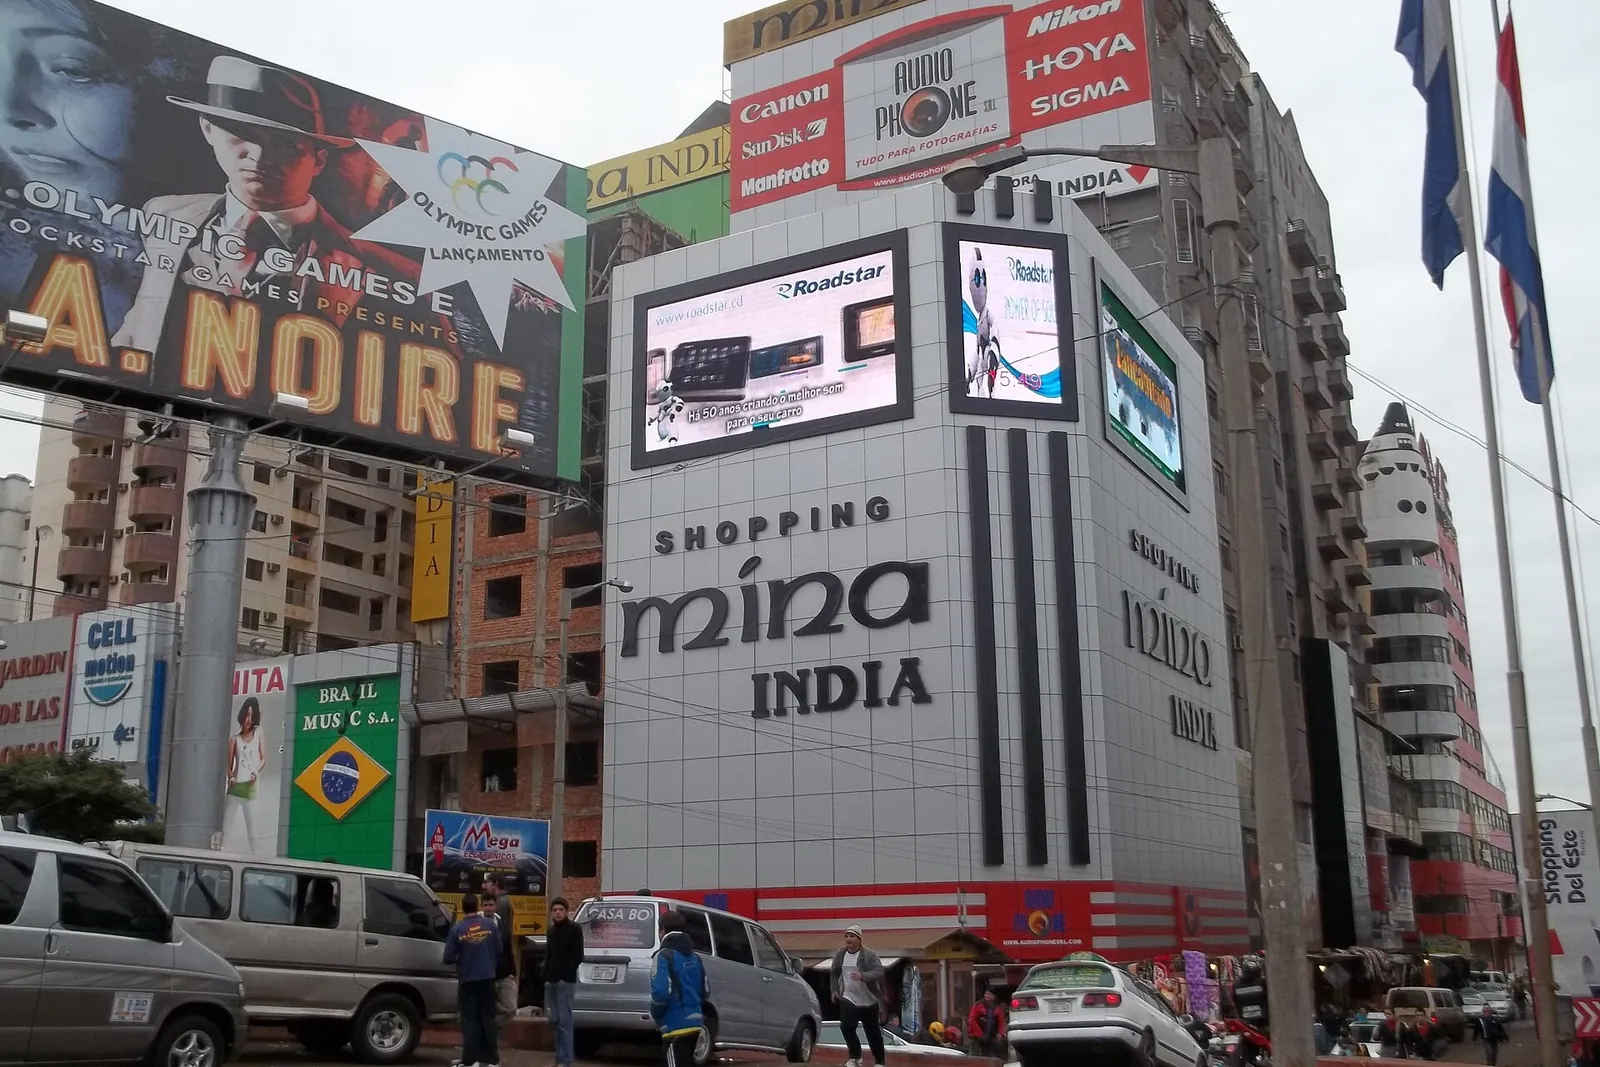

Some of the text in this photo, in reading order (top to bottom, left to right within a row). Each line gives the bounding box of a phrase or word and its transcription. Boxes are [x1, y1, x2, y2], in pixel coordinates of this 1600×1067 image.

[1026, 0, 1121, 38] Nikon
[895, 48, 953, 96] AUDIO
[1022, 32, 1136, 81] HOYA
[740, 83, 829, 124] Canon
[1031, 76, 1130, 117] SIGMA
[741, 126, 804, 160] SanDisk
[856, 123, 999, 168] TUDO PARA FOTOGRAFIAS
[741, 157, 830, 197] Manfrotto
[1057, 168, 1123, 196] INDIA
[413, 191, 548, 241] OLYMPIC GAMES
[429, 247, 545, 264] LANÇAMENTO
[262, 247, 416, 305] GAMES
[792, 264, 886, 298] Roadstar
[192, 265, 300, 304] GAMES
[316, 297, 459, 345] PRESENTS
[181, 288, 526, 460] NOIRE
[702, 406, 717, 418] 50
[718, 404, 741, 416] anos
[743, 395, 778, 410] criando
[780, 394, 786, 403] o
[788, 388, 821, 402] melhor
[823, 383, 844, 394] som
[726, 406, 803, 434] para o seu carro
[654, 496, 889, 553] SHOPPING
[1129, 529, 1200, 594] SHOPPING
[87, 617, 137, 650] CELL
[85, 652, 136, 677] motion
[752, 657, 932, 718] INDIA
[25, 696, 60, 722] LAS
[367, 711, 395, 725] S.A.
[1169, 694, 1217, 751] INDIA
[71, 736, 100, 749] BLU
[462, 819, 520, 851] Mega
[1538, 818, 1562, 904] Shopping
[1562, 829, 1586, 904] Del Este
[628, 908, 651, 921] BO
